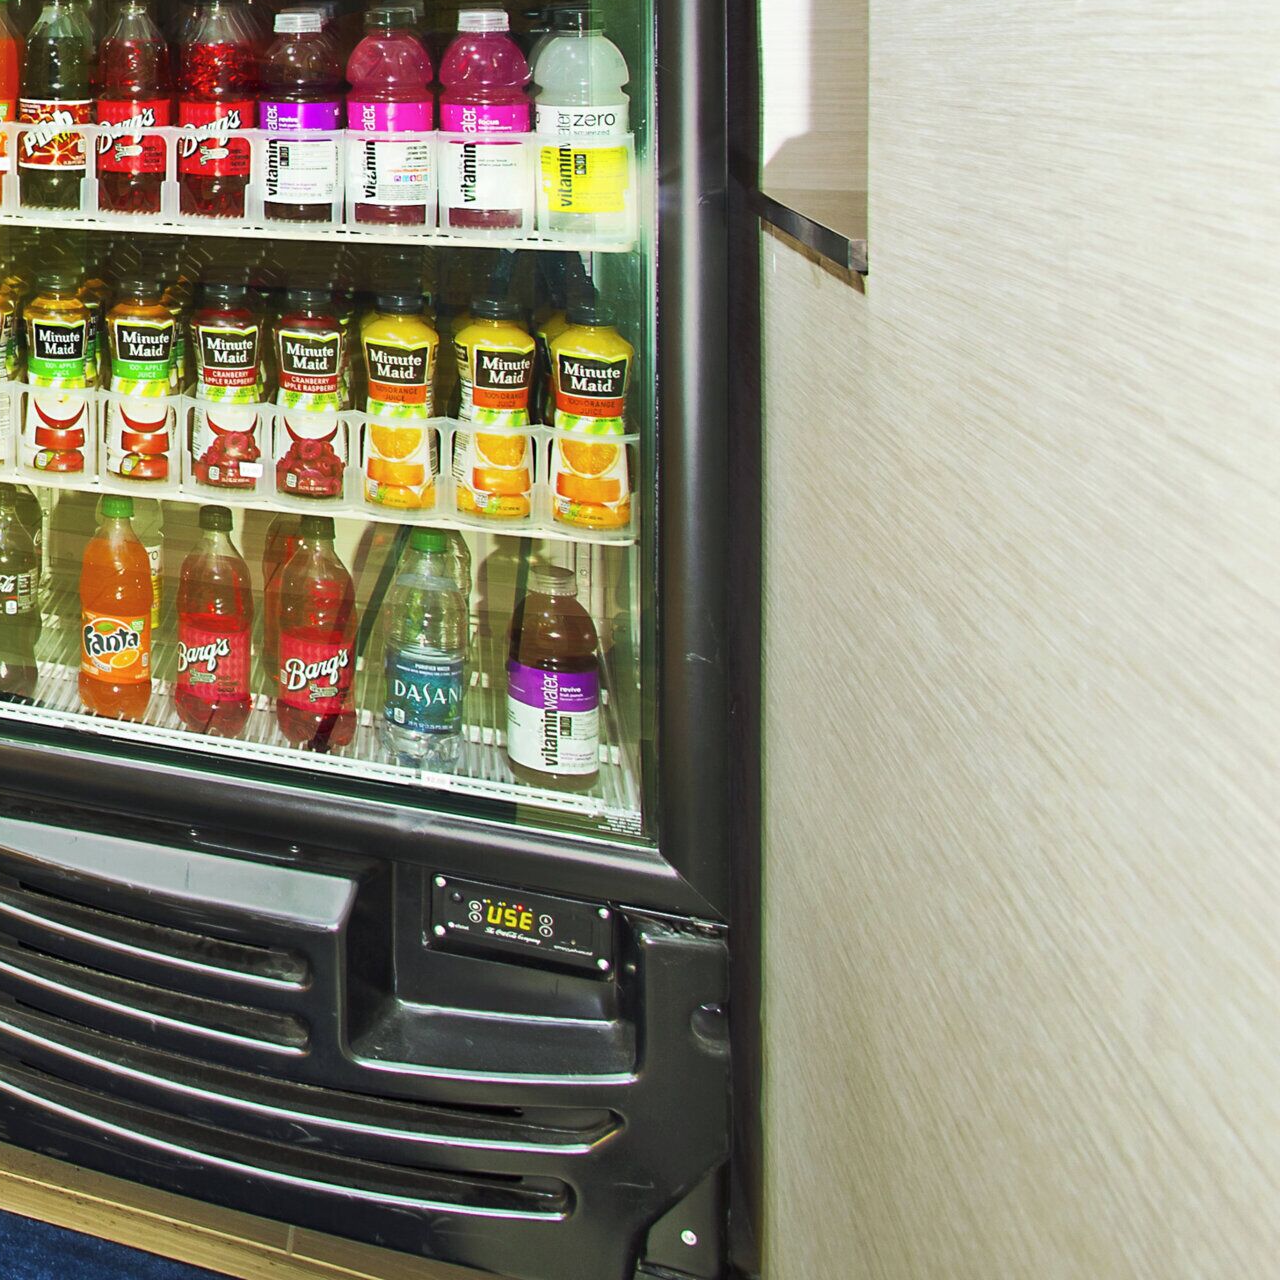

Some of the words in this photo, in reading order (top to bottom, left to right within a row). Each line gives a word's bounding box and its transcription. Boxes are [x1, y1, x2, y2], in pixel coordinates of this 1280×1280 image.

[573, 113, 616, 128] zero
[39, 330, 81, 345] Minute
[121, 330, 171, 346] Minute
[205, 337, 254, 352] Minute
[44, 341, 78, 356] Maid
[128, 344, 166, 358] Maid
[285, 341, 335, 359] Minute
[212, 350, 250, 365] Maid
[291, 357, 330, 371] Maid
[369, 351, 423, 368] Minute
[481, 355, 531, 372] Minute
[211, 370, 250, 379] CRANBERRY
[376, 364, 417, 380] Maid
[488, 370, 524, 385] Maid
[563, 361, 622, 380] Minute
[290, 376, 331, 386] CRANBERRY
[570, 376, 615, 393] Maid
[84, 627, 141, 658] Fanta
[177, 636, 231, 673] Barq's
[285, 648, 351, 692] Barq's
[486, 904, 534, 931] USE
